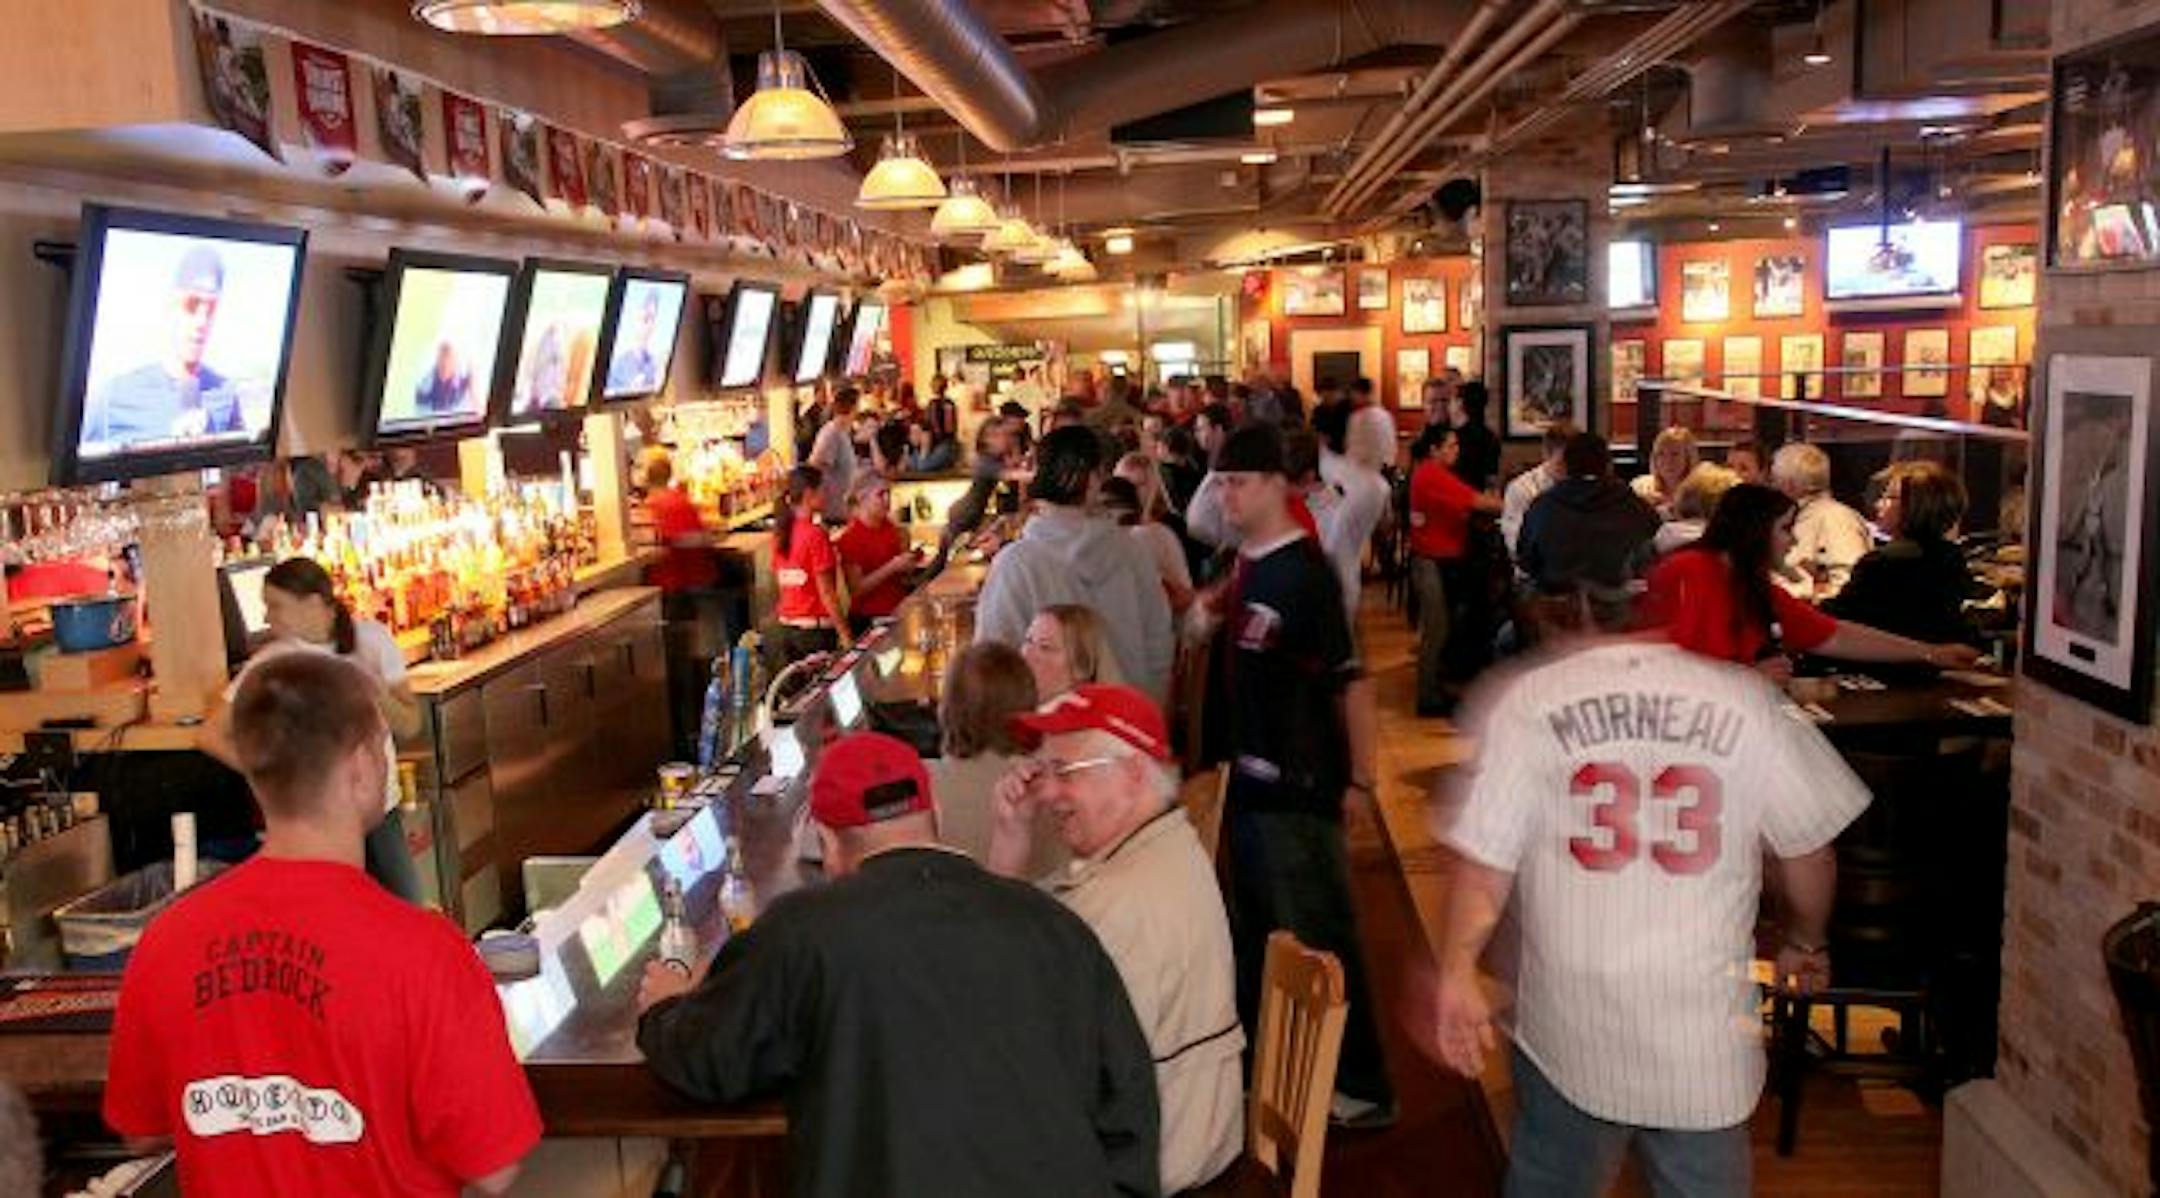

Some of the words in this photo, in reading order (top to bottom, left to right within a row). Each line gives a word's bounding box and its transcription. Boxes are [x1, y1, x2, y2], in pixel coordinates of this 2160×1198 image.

[1549, 691, 1744, 757] MORNEAU
[1568, 762, 1723, 875] 33
[205, 929, 326, 971] CAPTAIN
[193, 957, 333, 1021] BEDROCK
[189, 1082, 351, 1122] HUET
